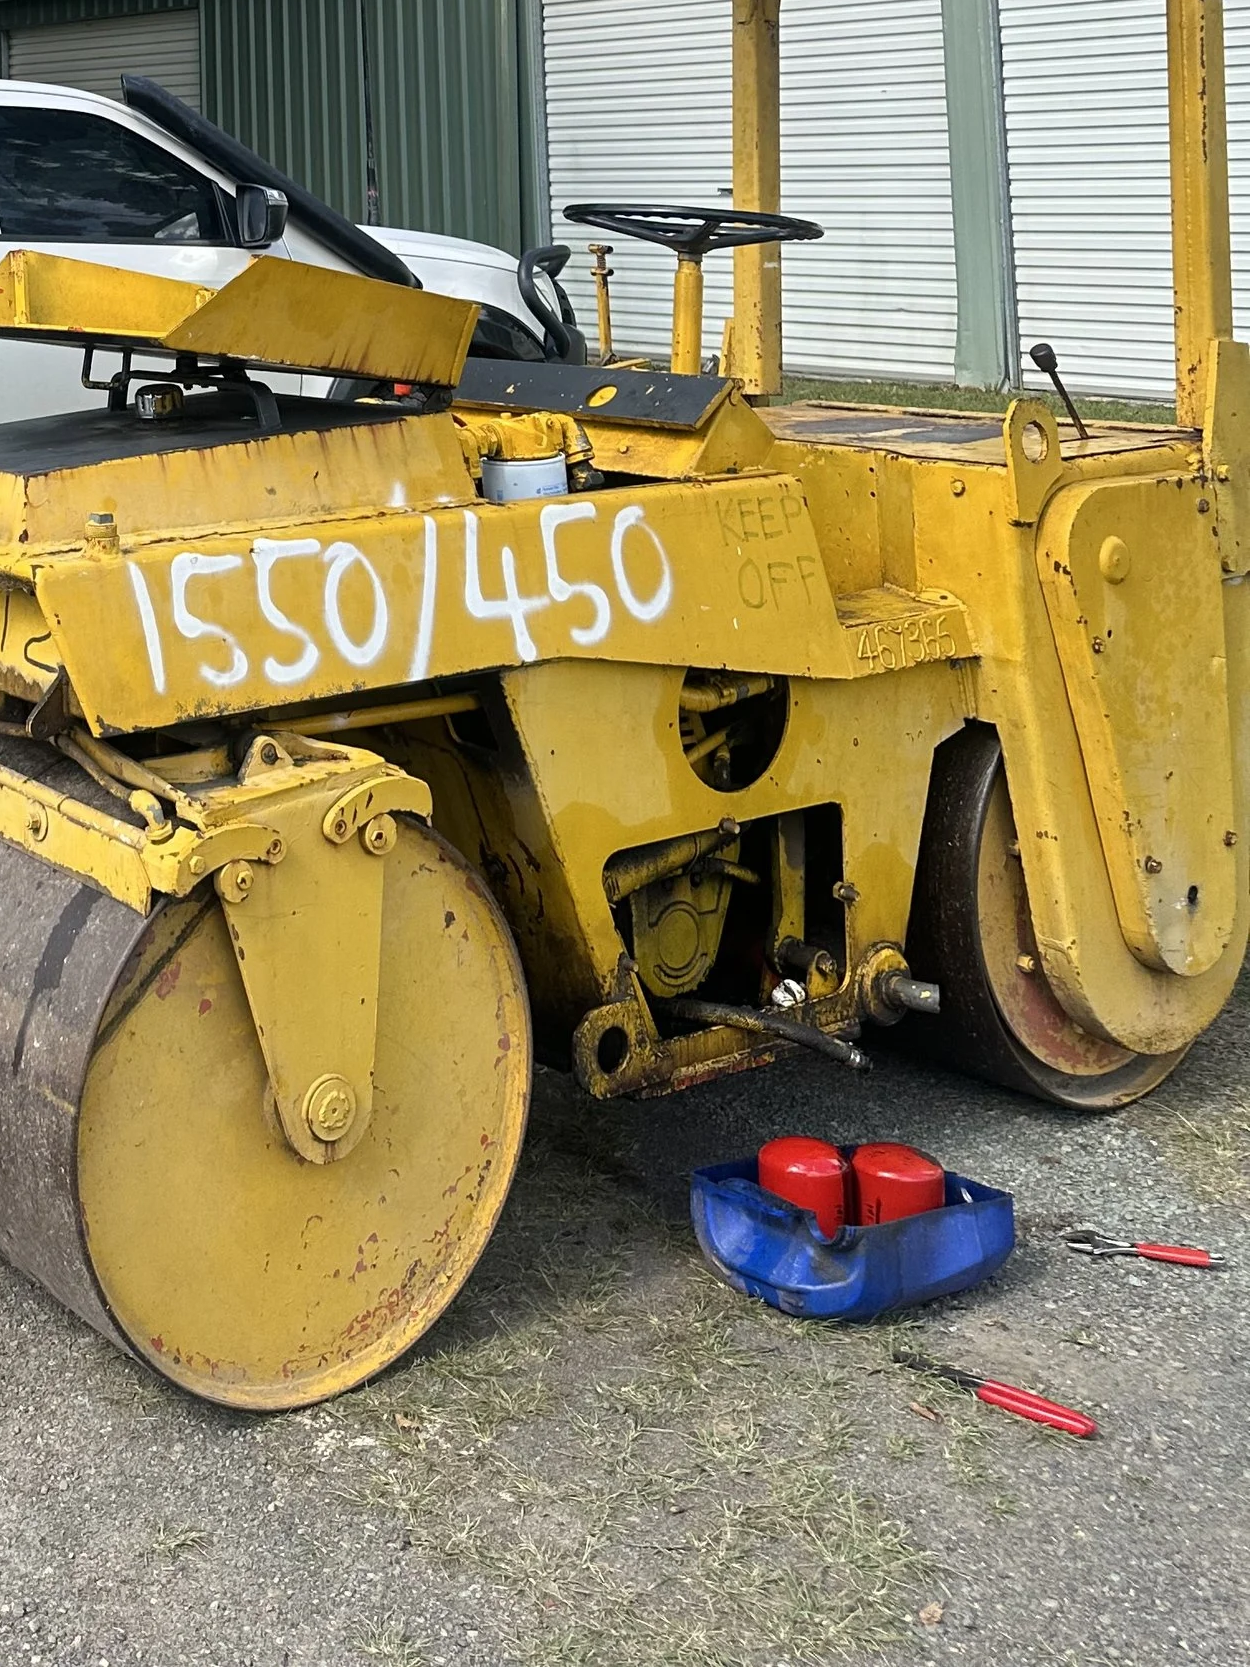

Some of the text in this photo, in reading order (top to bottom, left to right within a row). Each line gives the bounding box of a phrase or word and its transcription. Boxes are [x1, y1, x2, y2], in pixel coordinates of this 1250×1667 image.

[715, 494, 801, 547] KEEP
[126, 500, 674, 696] 1550/450
[737, 554, 816, 613] OFF
